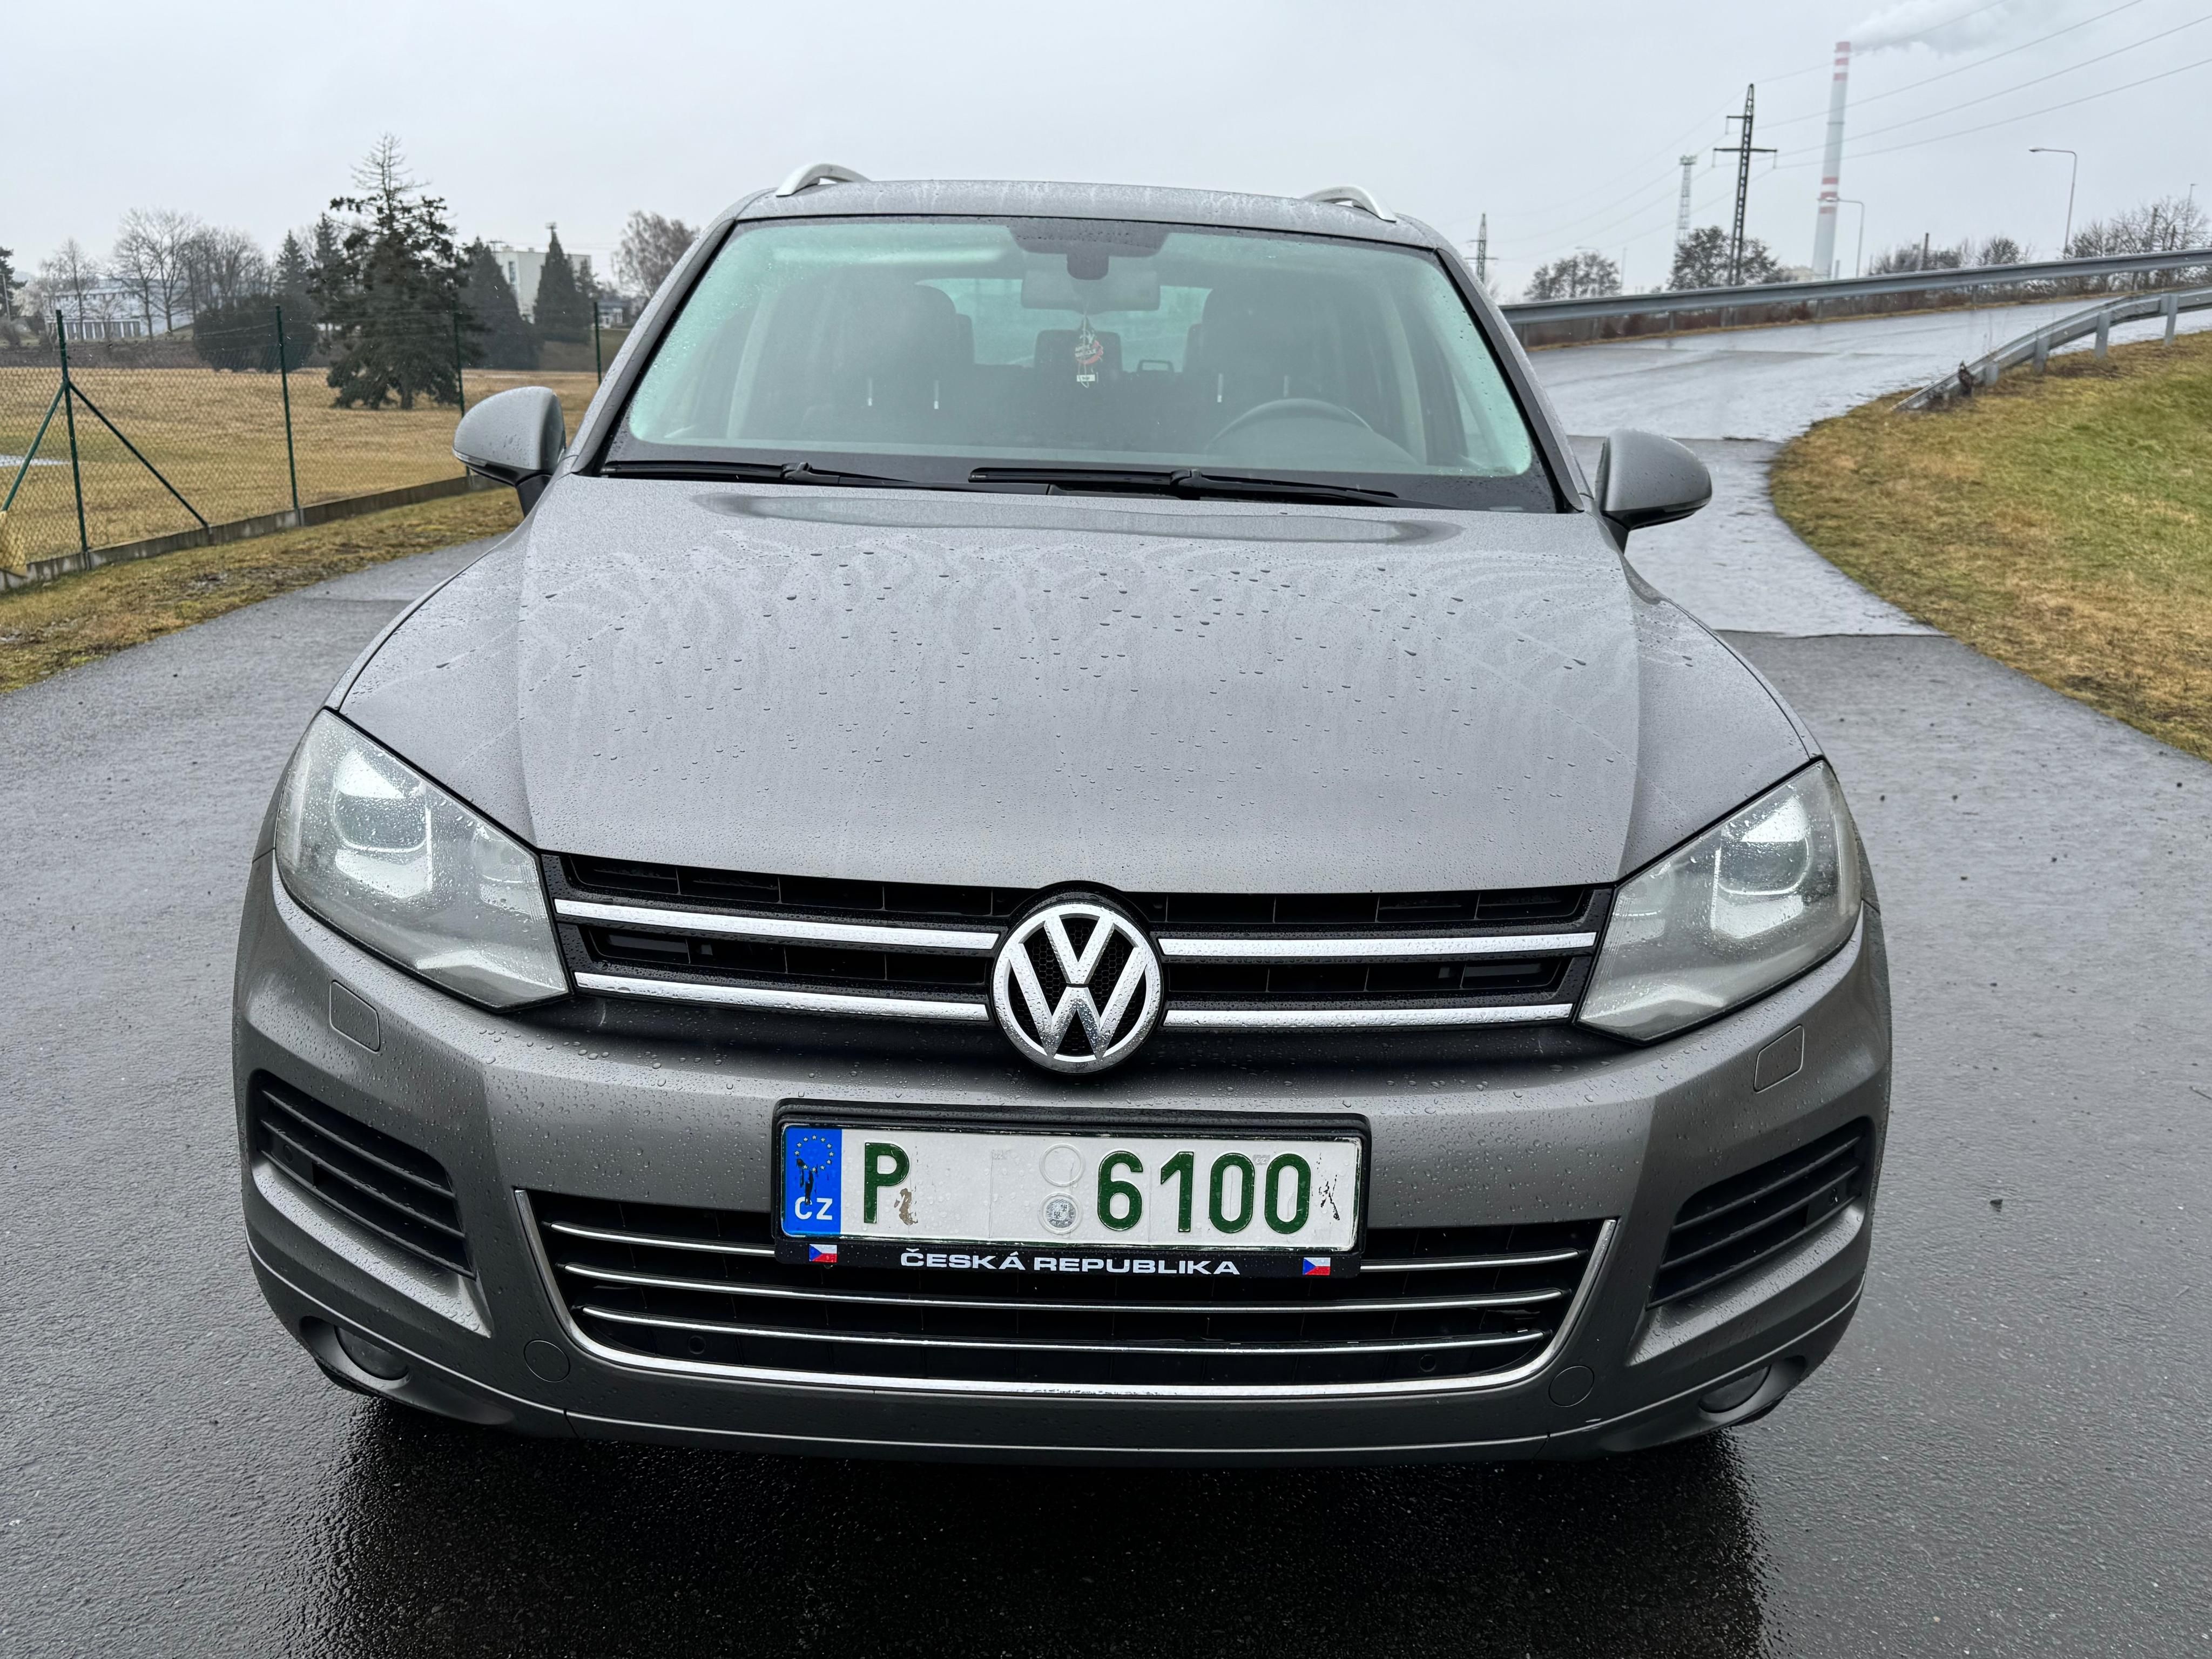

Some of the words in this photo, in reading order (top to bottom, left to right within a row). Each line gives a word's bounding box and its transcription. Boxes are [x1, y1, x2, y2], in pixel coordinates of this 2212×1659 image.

[1003, 909, 1151, 1063] VW
[794, 1196, 833, 1220] CZ
[864, 1142, 911, 1224] P
[1097, 1150, 1312, 1235] 6100
[900, 1247, 1027, 1271] ČESKÁ
[1034, 1256, 1241, 1275] REPUBLIKA
